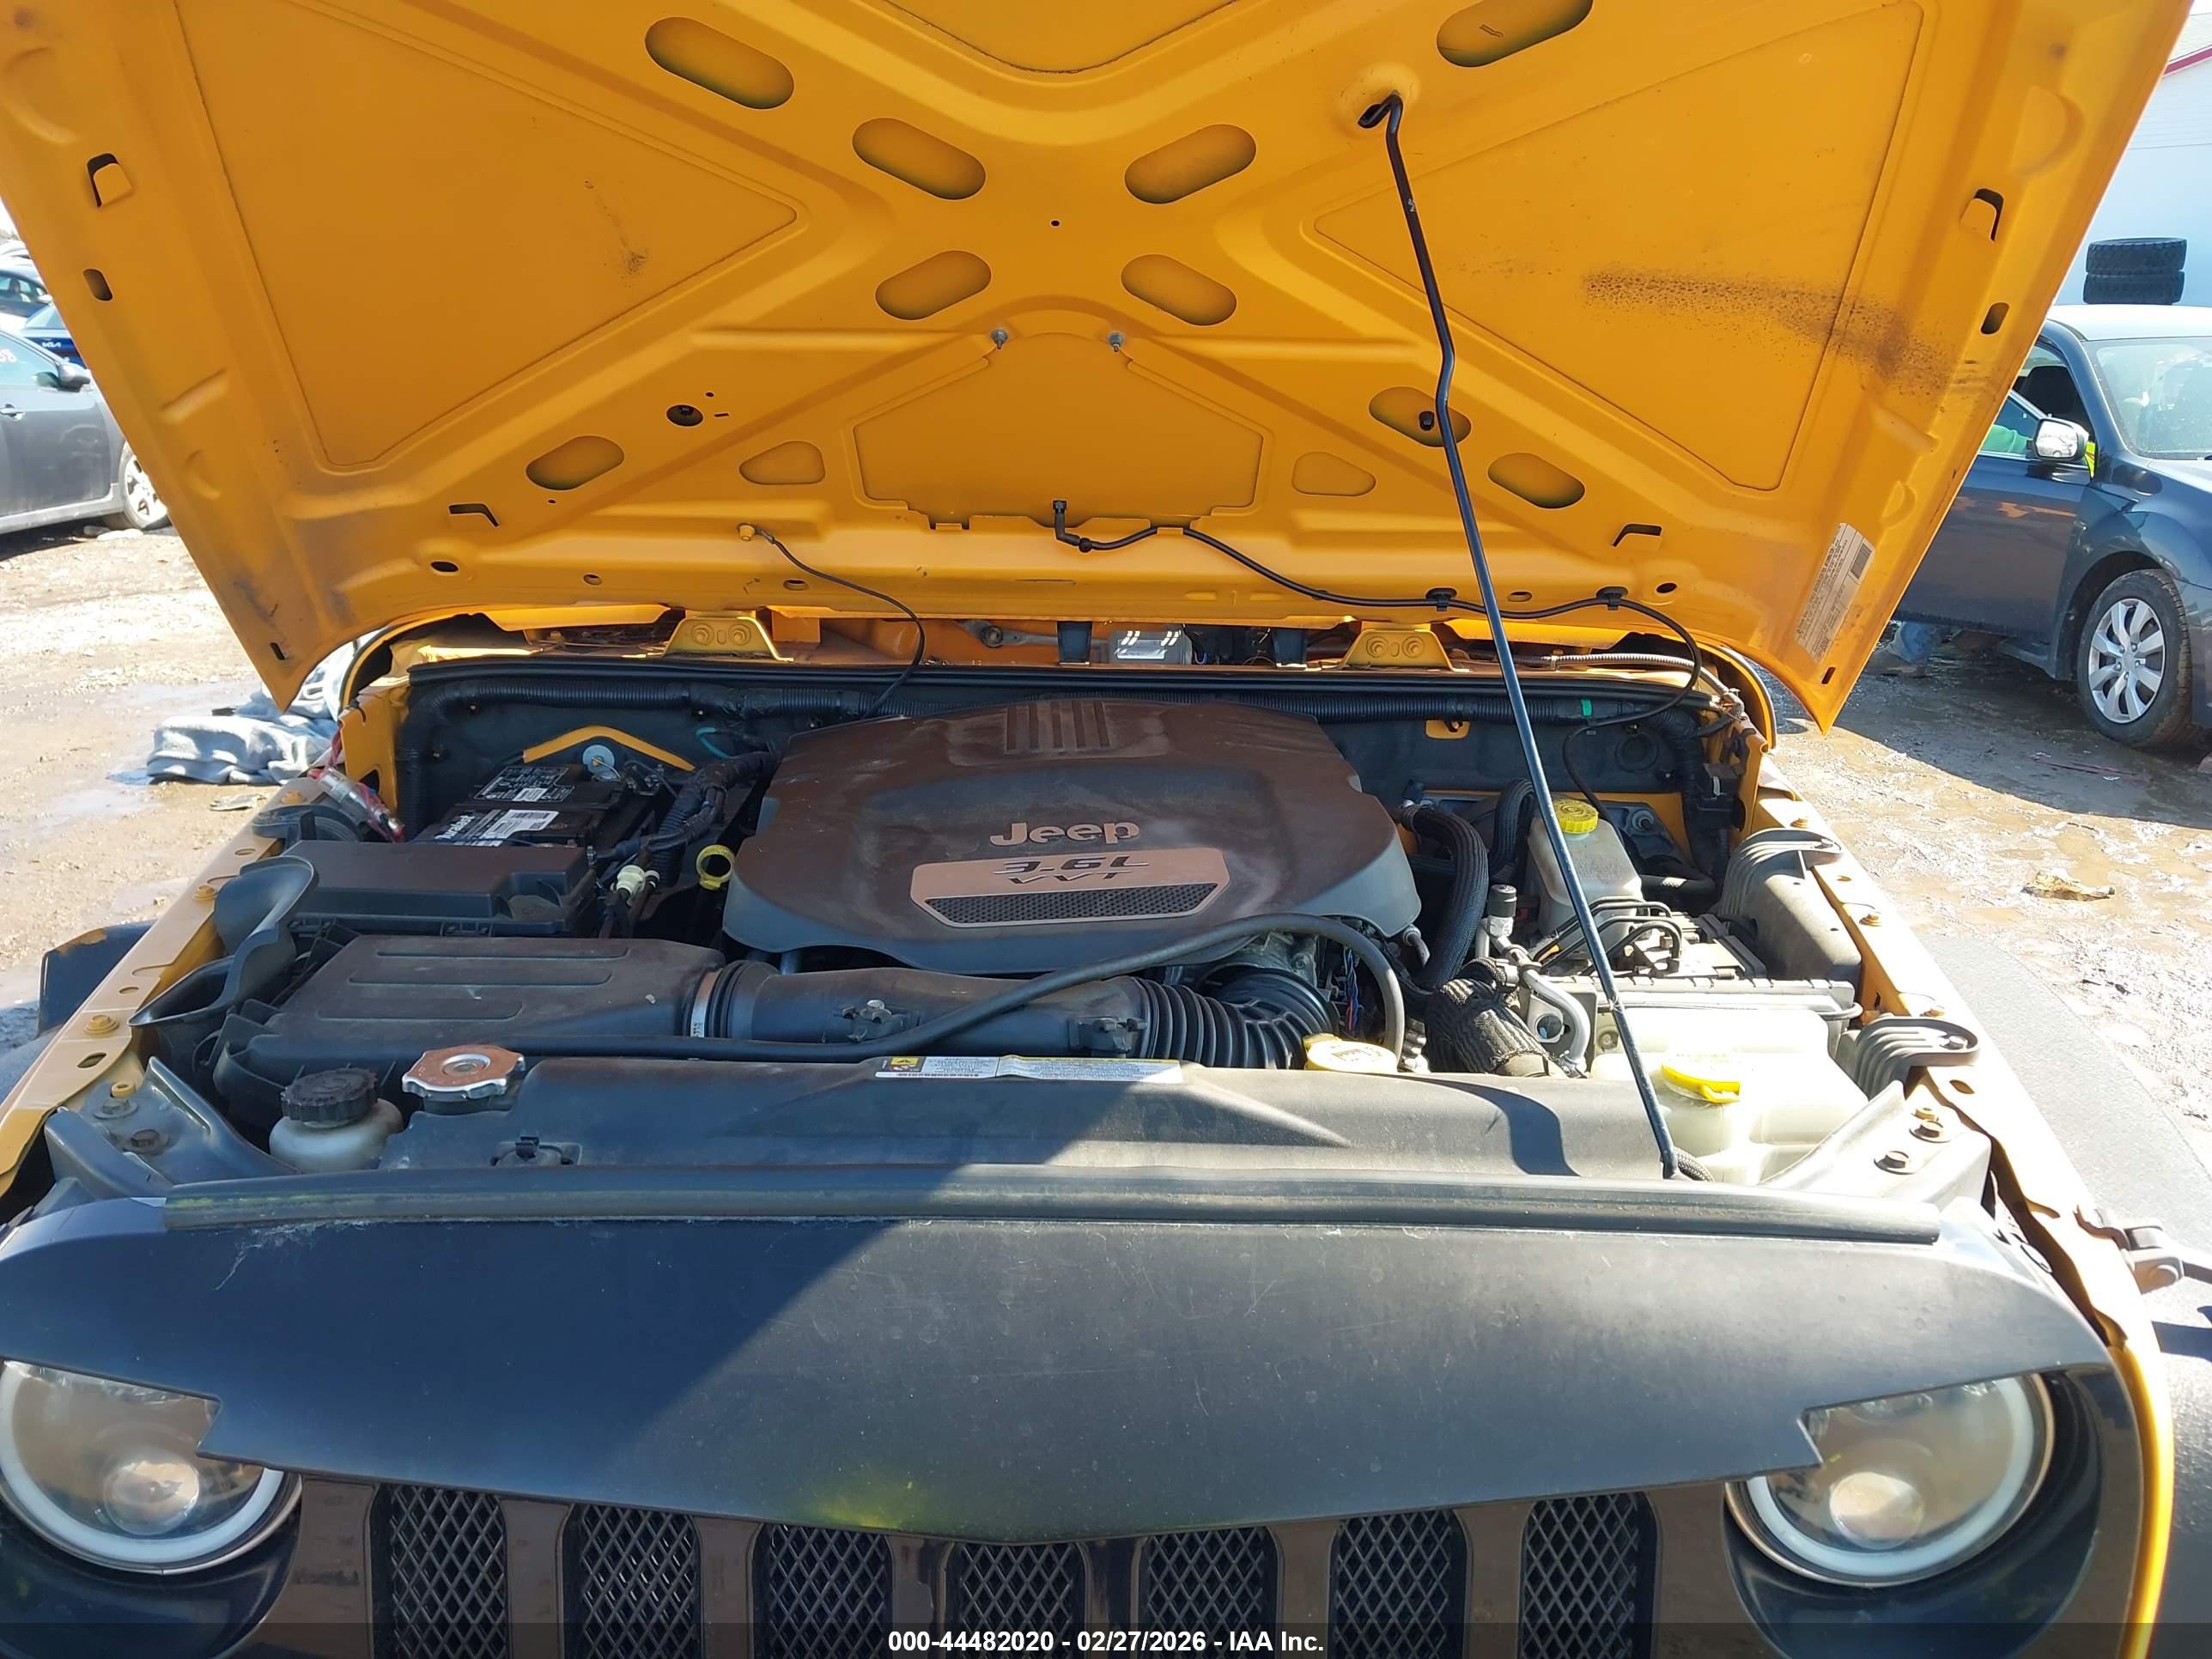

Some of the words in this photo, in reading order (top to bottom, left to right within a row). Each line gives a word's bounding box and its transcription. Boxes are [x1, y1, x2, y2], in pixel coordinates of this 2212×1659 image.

[989, 821, 1140, 847] Jeep
[994, 855, 1149, 874] 3.6L
[1007, 870, 1133, 884] VVT
